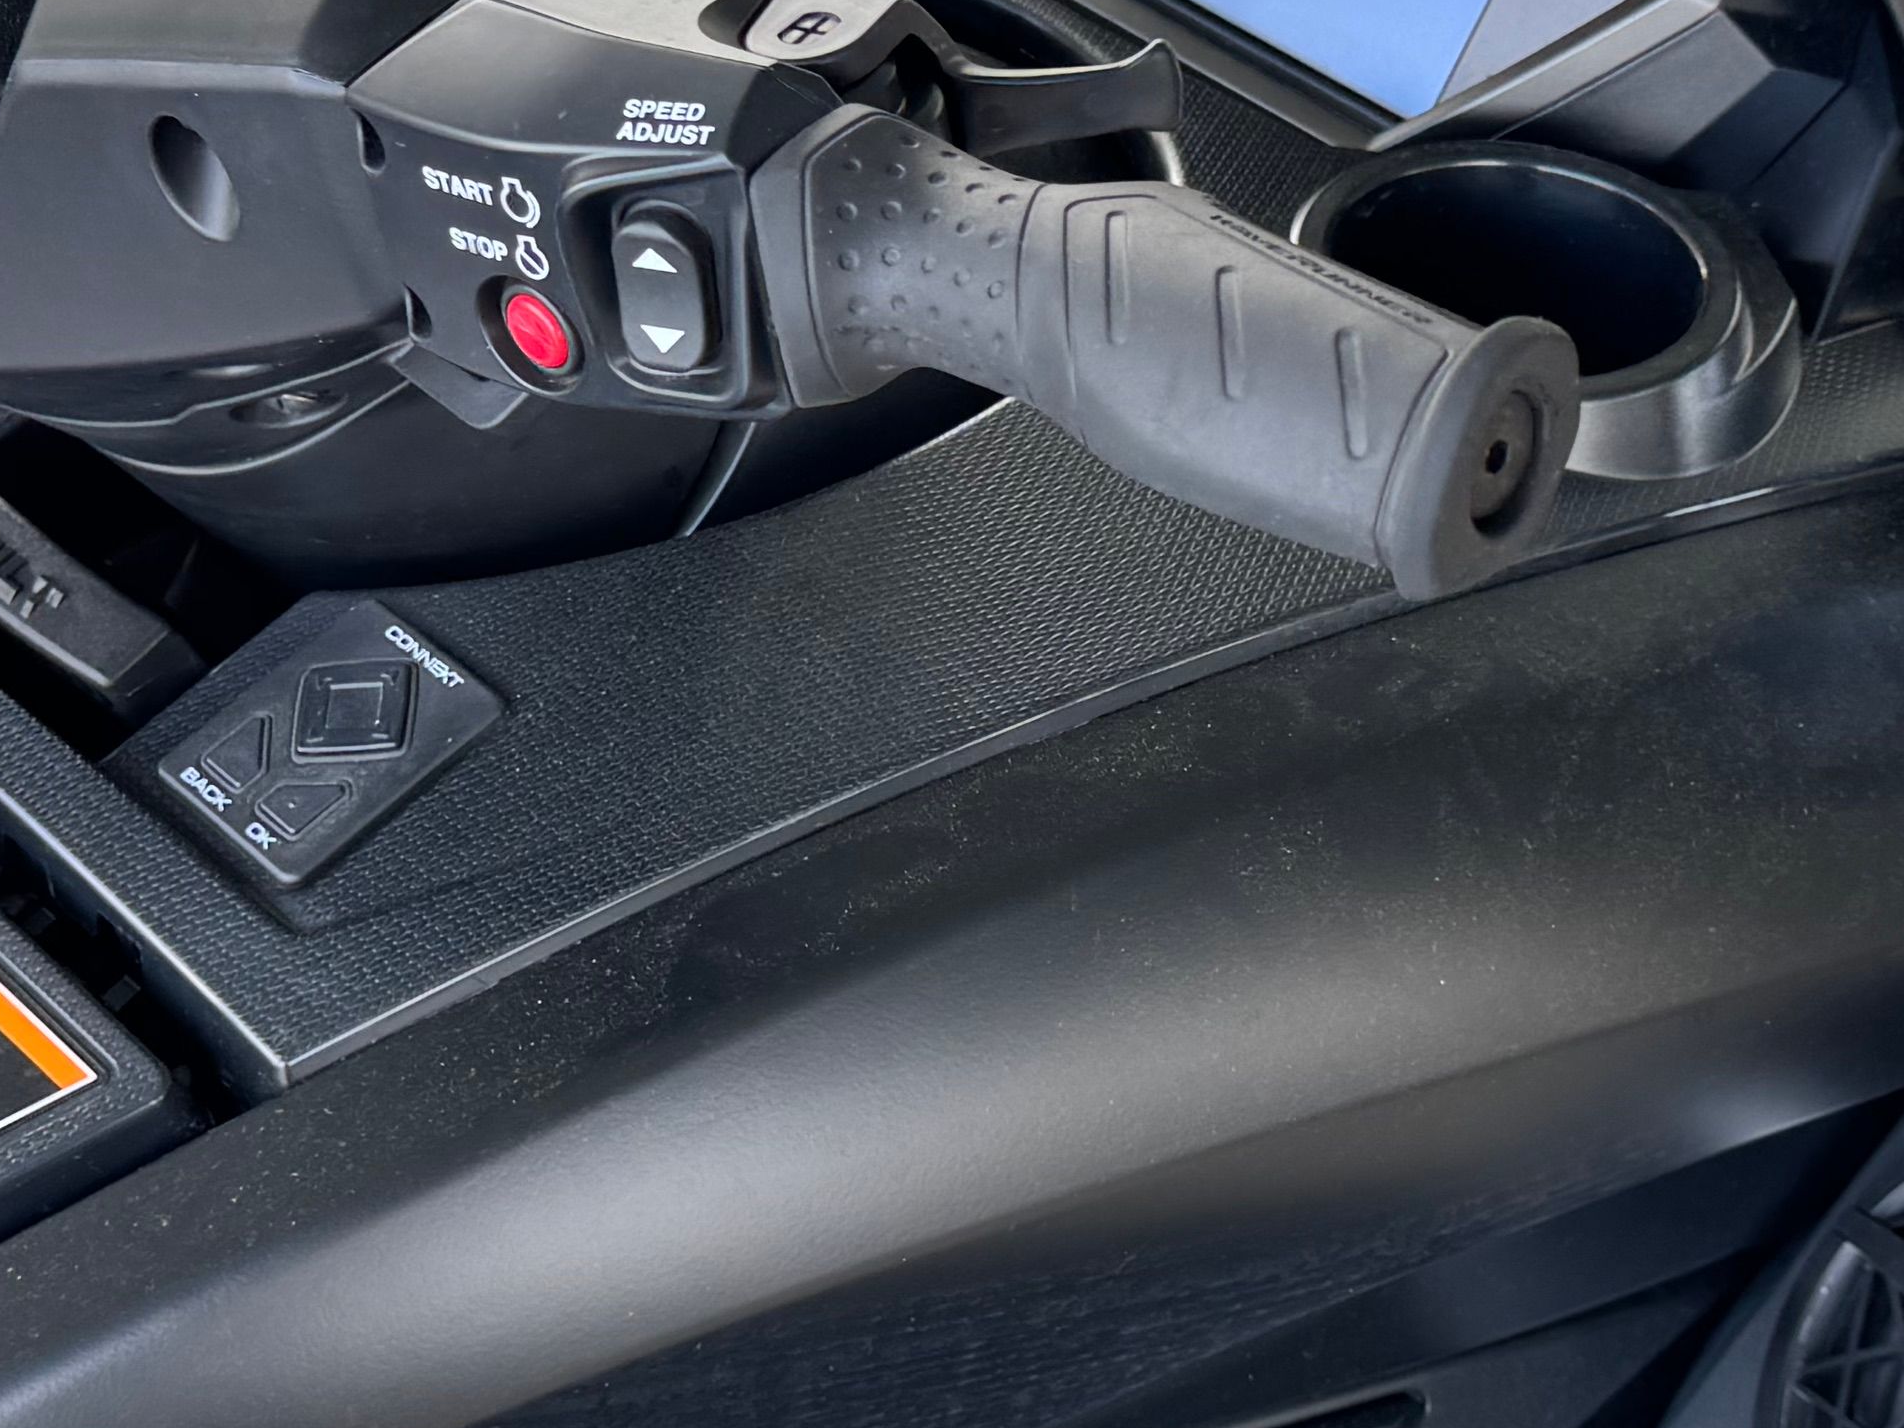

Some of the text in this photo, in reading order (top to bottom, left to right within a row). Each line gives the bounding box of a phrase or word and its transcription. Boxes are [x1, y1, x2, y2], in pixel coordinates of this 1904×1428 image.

[623, 99, 706, 122] SPEED
[616, 122, 714, 146] ADJUST
[422, 165, 493, 207] START
[450, 227, 508, 262] STOP
[384, 625, 465, 688] CONNEXT
[179, 766, 233, 812] BACK
[244, 822, 277, 850] OK
